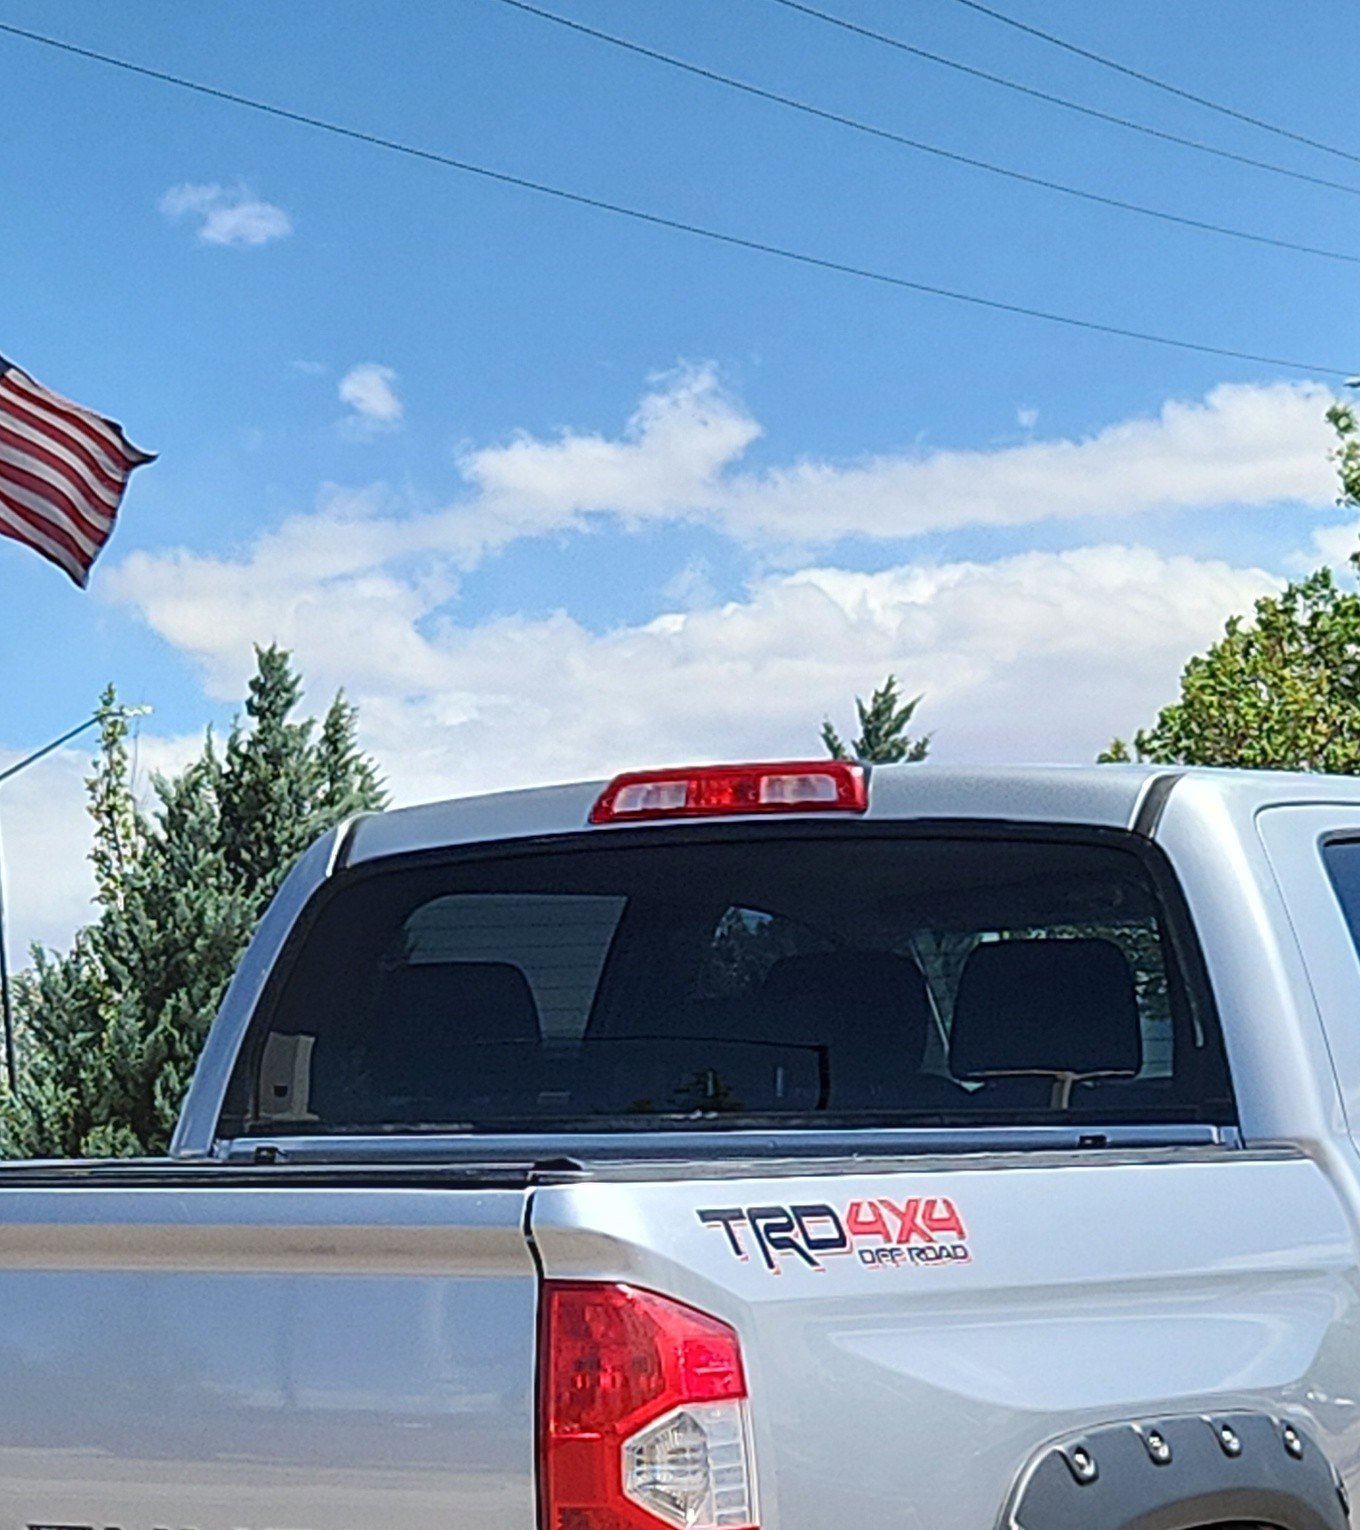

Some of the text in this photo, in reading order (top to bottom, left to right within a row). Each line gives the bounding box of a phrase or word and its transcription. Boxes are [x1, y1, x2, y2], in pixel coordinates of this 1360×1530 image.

[695, 1203, 849, 1272] TRD
[858, 1243, 971, 1267] OFF ROAD
